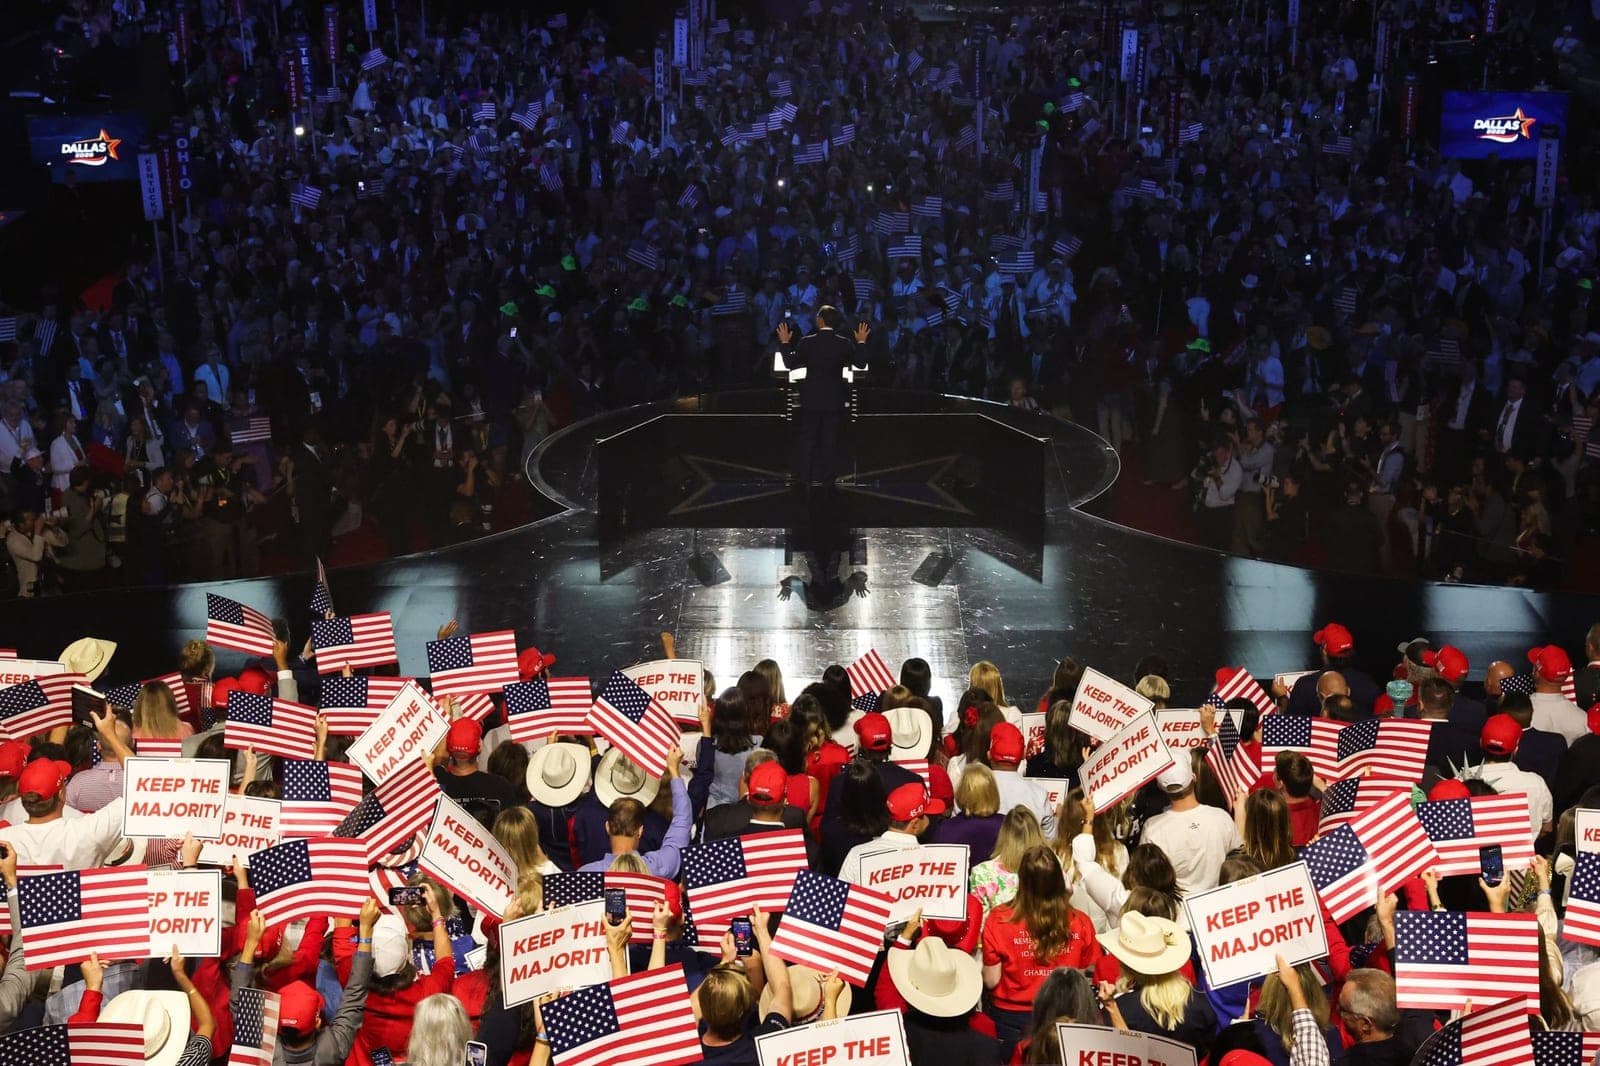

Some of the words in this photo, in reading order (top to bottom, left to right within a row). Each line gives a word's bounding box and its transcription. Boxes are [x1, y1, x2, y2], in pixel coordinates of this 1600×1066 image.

[299, 47, 312, 93] TEXAS
[1473, 119, 1520, 130] DALLAS
[61, 142, 106, 154] DALLAS
[175, 138, 192, 189] OHIO
[1542, 143, 1553, 202] FLORIDA
[144, 158, 157, 215] KENTUCKY
[669, 673, 696, 685] THE
[653, 691, 700, 703] JORITY
[1083, 684, 1112, 704] KEEP
[1113, 699, 1139, 718] THE
[365, 726, 396, 763] KEEP
[396, 699, 421, 728] THE
[1162, 722, 1200, 732] KEEP
[376, 711, 434, 780] MAJORITY
[1087, 748, 1120, 780] KEEP
[1122, 726, 1150, 751] THE
[1165, 738, 1209, 748] AJOR
[1088, 740, 1159, 795] MAJORITY
[135, 777, 186, 792] KEEP
[190, 779, 221, 793] THE
[130, 802, 222, 818] MAJORITY
[240, 813, 273, 829] THE
[202, 833, 275, 849] JORITY
[443, 815, 484, 849] KEEP
[487, 848, 512, 880] THE
[433, 833, 514, 898] MAJORITY
[869, 864, 914, 886] KEEP
[919, 862, 957, 876] THE
[173, 891, 210, 907] THE
[893, 885, 960, 903] JORITY
[1206, 901, 1260, 932] KEEP
[1265, 887, 1304, 913] THE
[149, 918, 215, 934] JORITY
[1211, 914, 1315, 962] MAJORITY
[512, 928, 565, 957] KEEP
[510, 947, 609, 984] MAJORIT
[777, 1045, 836, 1066] KEEP
[843, 1036, 891, 1060] THE
